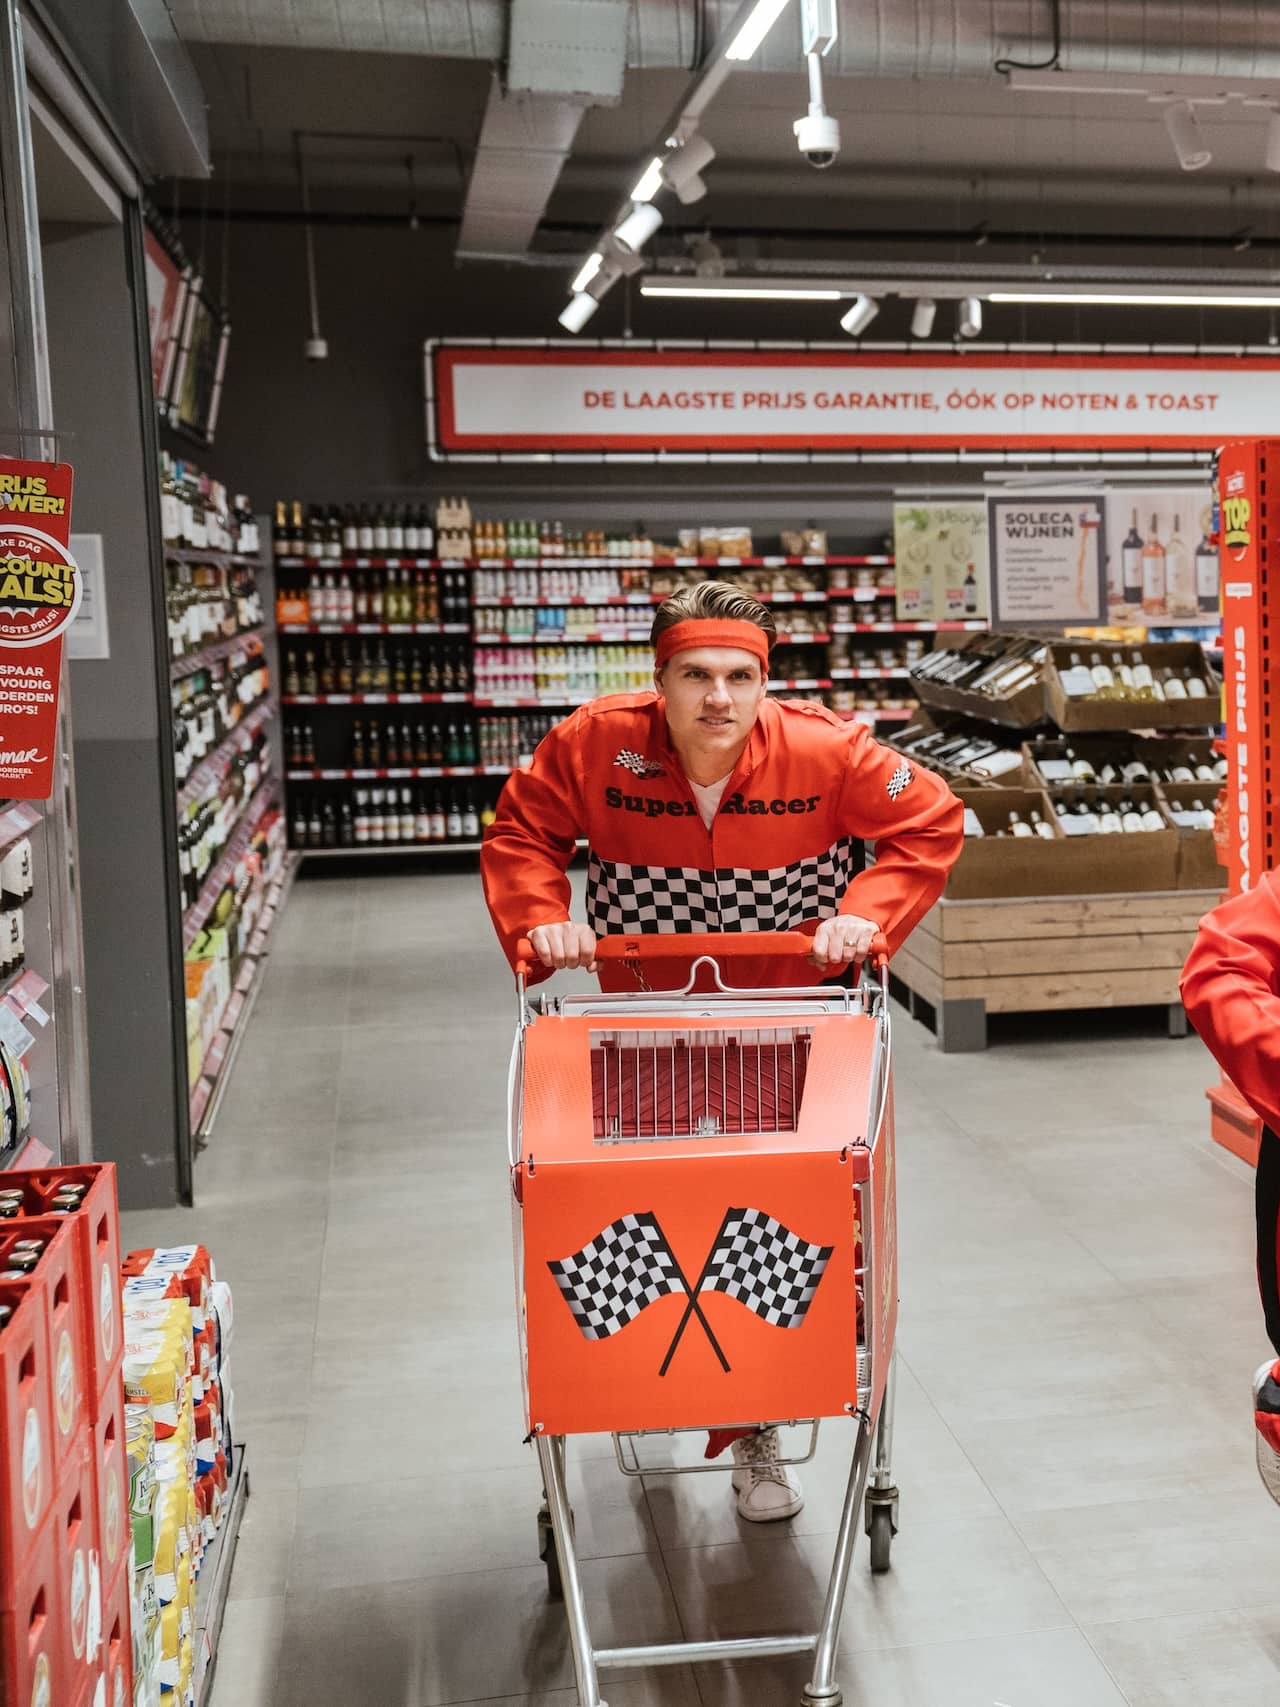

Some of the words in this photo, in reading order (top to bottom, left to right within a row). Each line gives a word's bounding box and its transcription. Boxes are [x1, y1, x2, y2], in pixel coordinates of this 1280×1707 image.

[583, 389, 616, 410] DE
[623, 390, 735, 411] LAAGSTE
[742, 391, 806, 410] PRIJS
[813, 391, 940, 414] GARANTIE,
[946, 388, 995, 411] ÓÓK
[1004, 392, 1035, 411] OP
[1042, 392, 1119, 412] NOTEN
[1125, 393, 1139, 412] &
[1146, 393, 1219, 412] TOAST
[0, 474, 47, 496] RIJS
[8, 494, 65, 516] WER!
[1222, 498, 1251, 531] TOP
[1005, 512, 1073, 525] SOLECA
[1005, 526, 1075, 539] WIJNEN
[18, 538, 42, 555] DAG
[0, 557, 76, 583] COUNT
[0, 574, 74, 608] ALS!
[0, 625, 31, 635] GSTE
[31, 608, 60, 632] PRIJS!
[0, 665, 44, 677] SPAAR
[0, 677, 52, 690] VOUDIG
[0, 691, 55, 704] DERDEN
